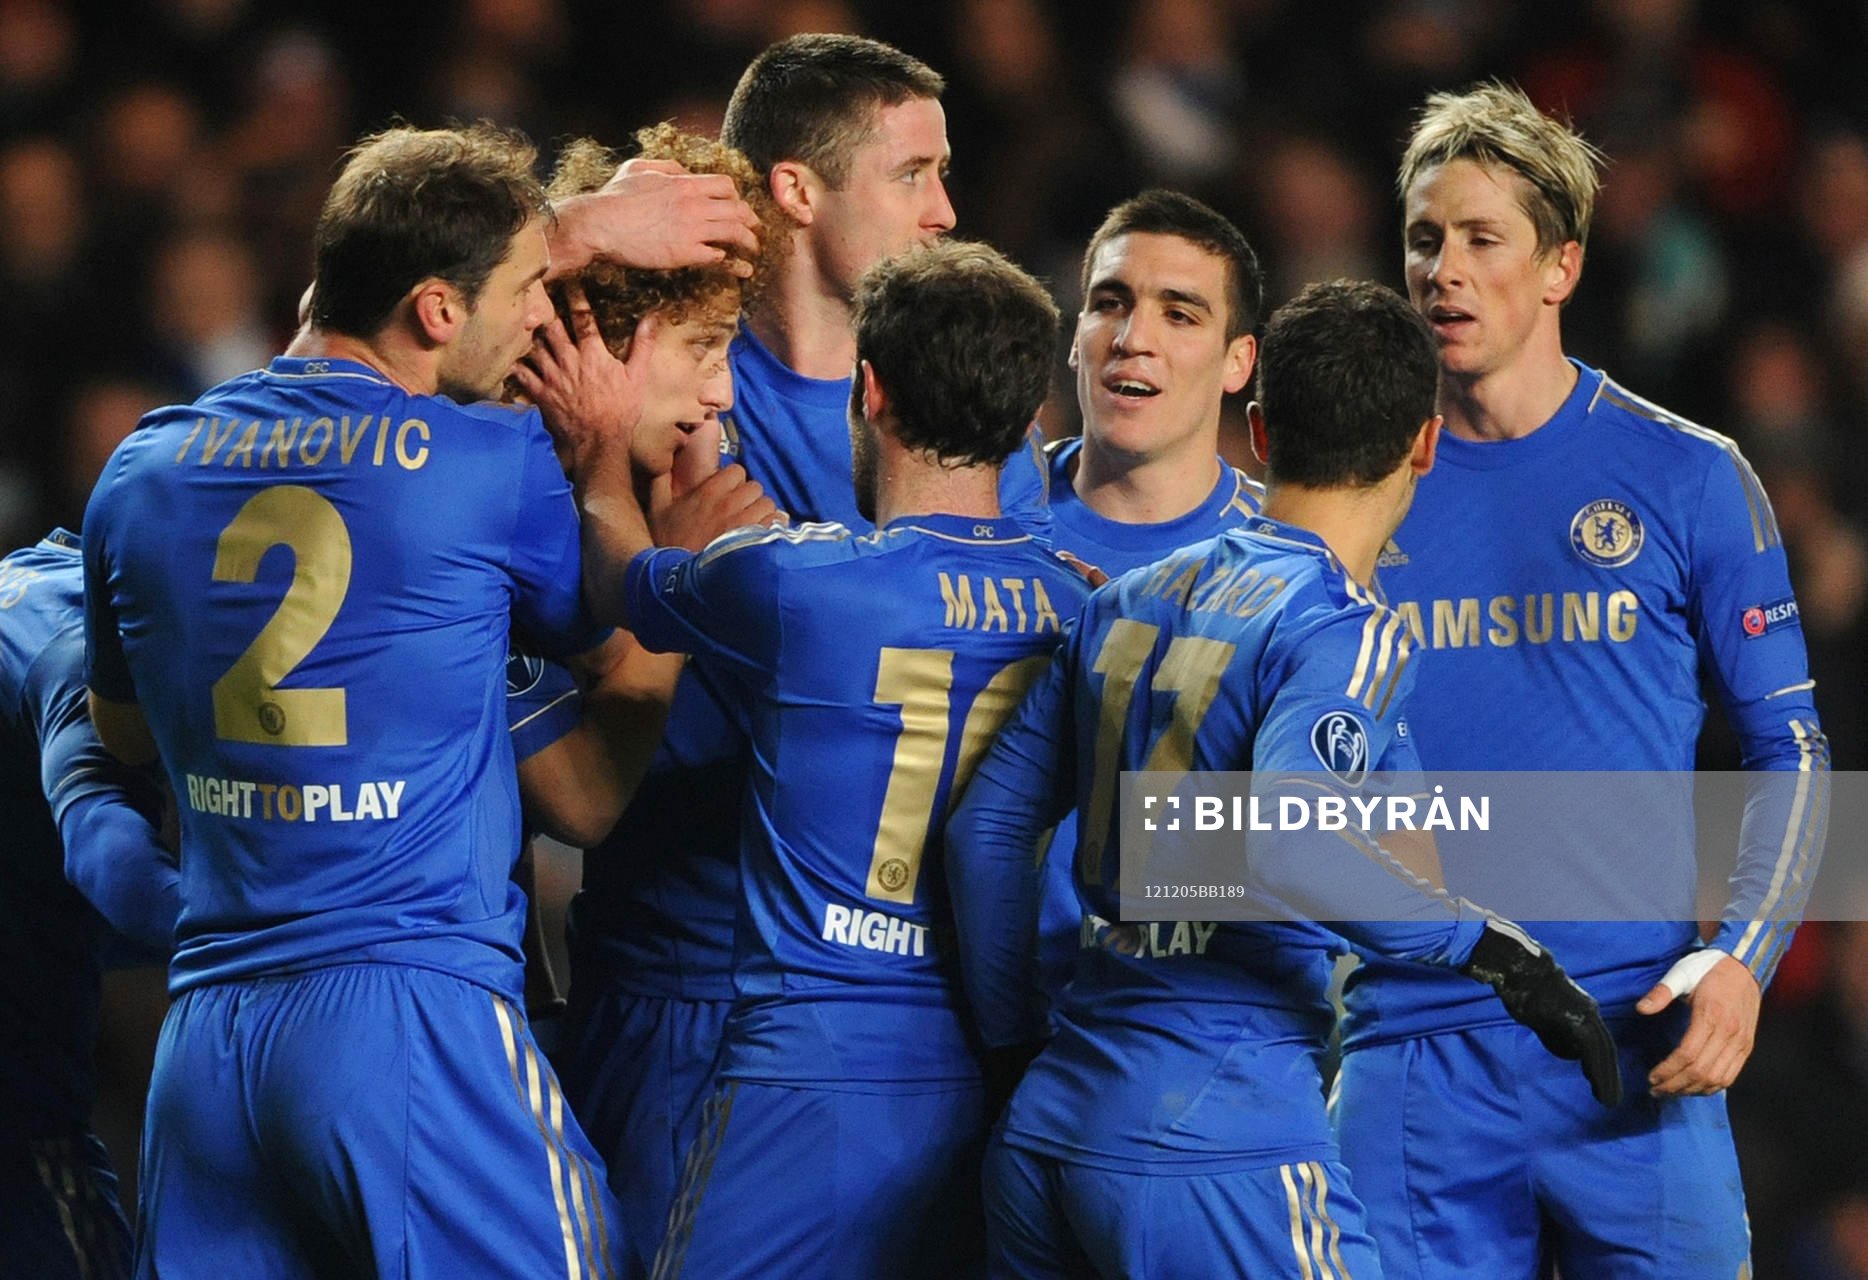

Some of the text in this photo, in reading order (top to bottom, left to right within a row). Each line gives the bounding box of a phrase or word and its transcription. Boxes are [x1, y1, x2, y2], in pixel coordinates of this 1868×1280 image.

[175, 414, 431, 471] IVANOVIC
[211, 484, 352, 747] 2
[938, 572, 1060, 634] MATA
[1398, 589, 1640, 650] AMSUNG
[822, 903, 930, 957] RIGHT
